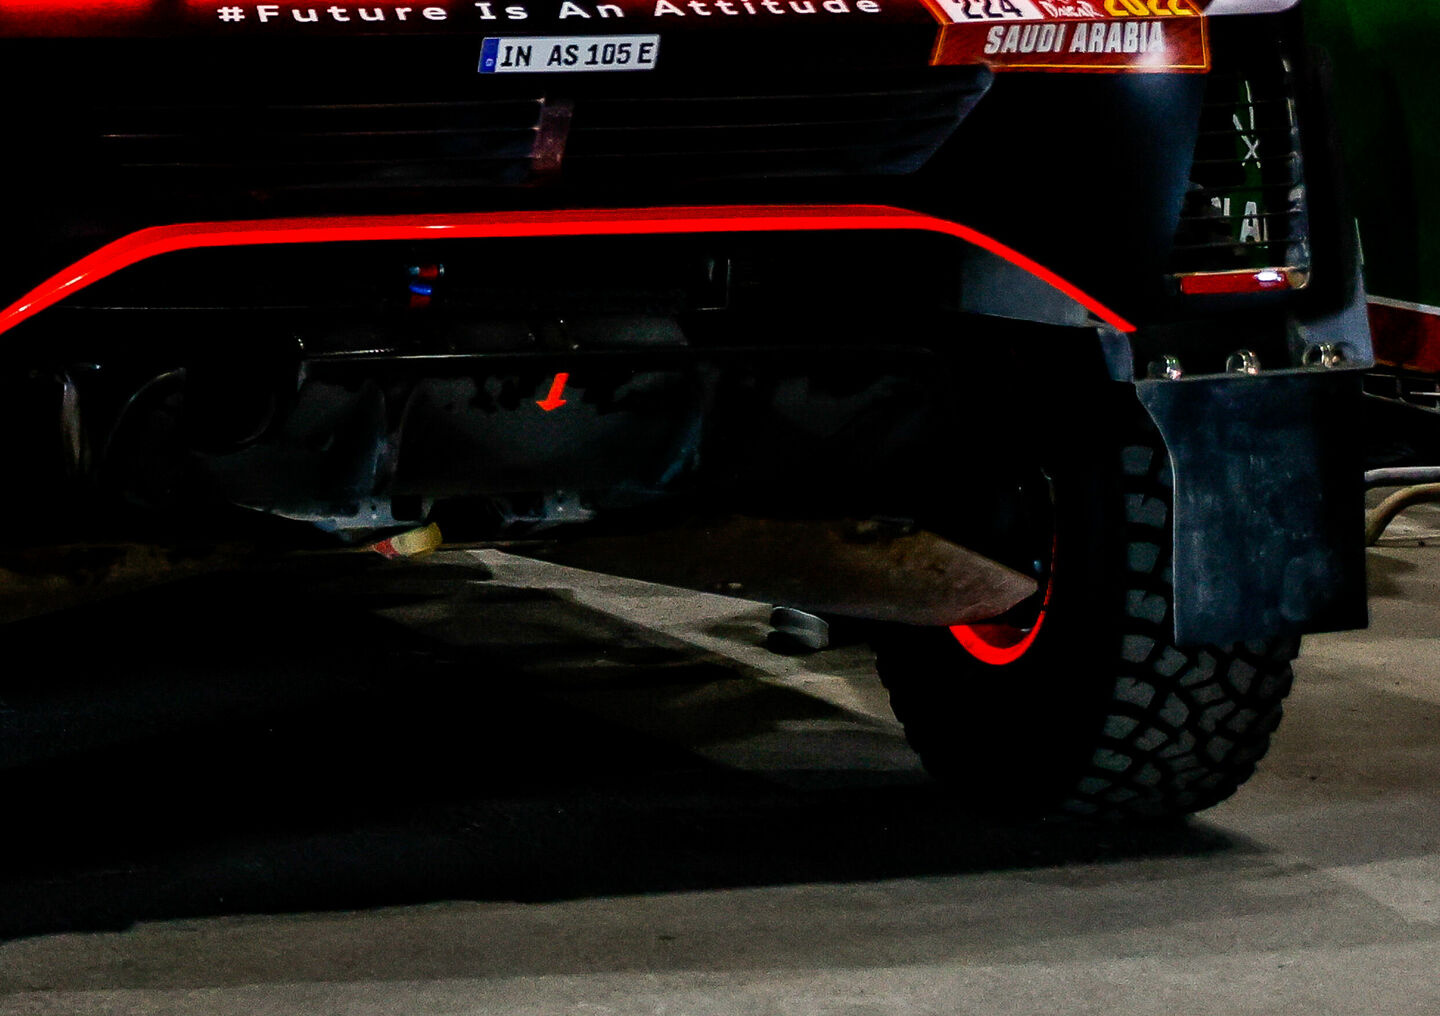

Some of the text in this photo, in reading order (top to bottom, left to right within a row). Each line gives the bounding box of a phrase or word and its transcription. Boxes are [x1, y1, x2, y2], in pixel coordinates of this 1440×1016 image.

[217, 4, 448, 22] #Future
[474, 2, 529, 20] Is
[558, 1, 626, 20] An
[984, 22, 1164, 54] SAUDI ARABIA
[500, 45, 532, 67] IN
[547, 44, 579, 66] AS
[584, 43, 632, 66] 105
[637, 43, 655, 64] E
